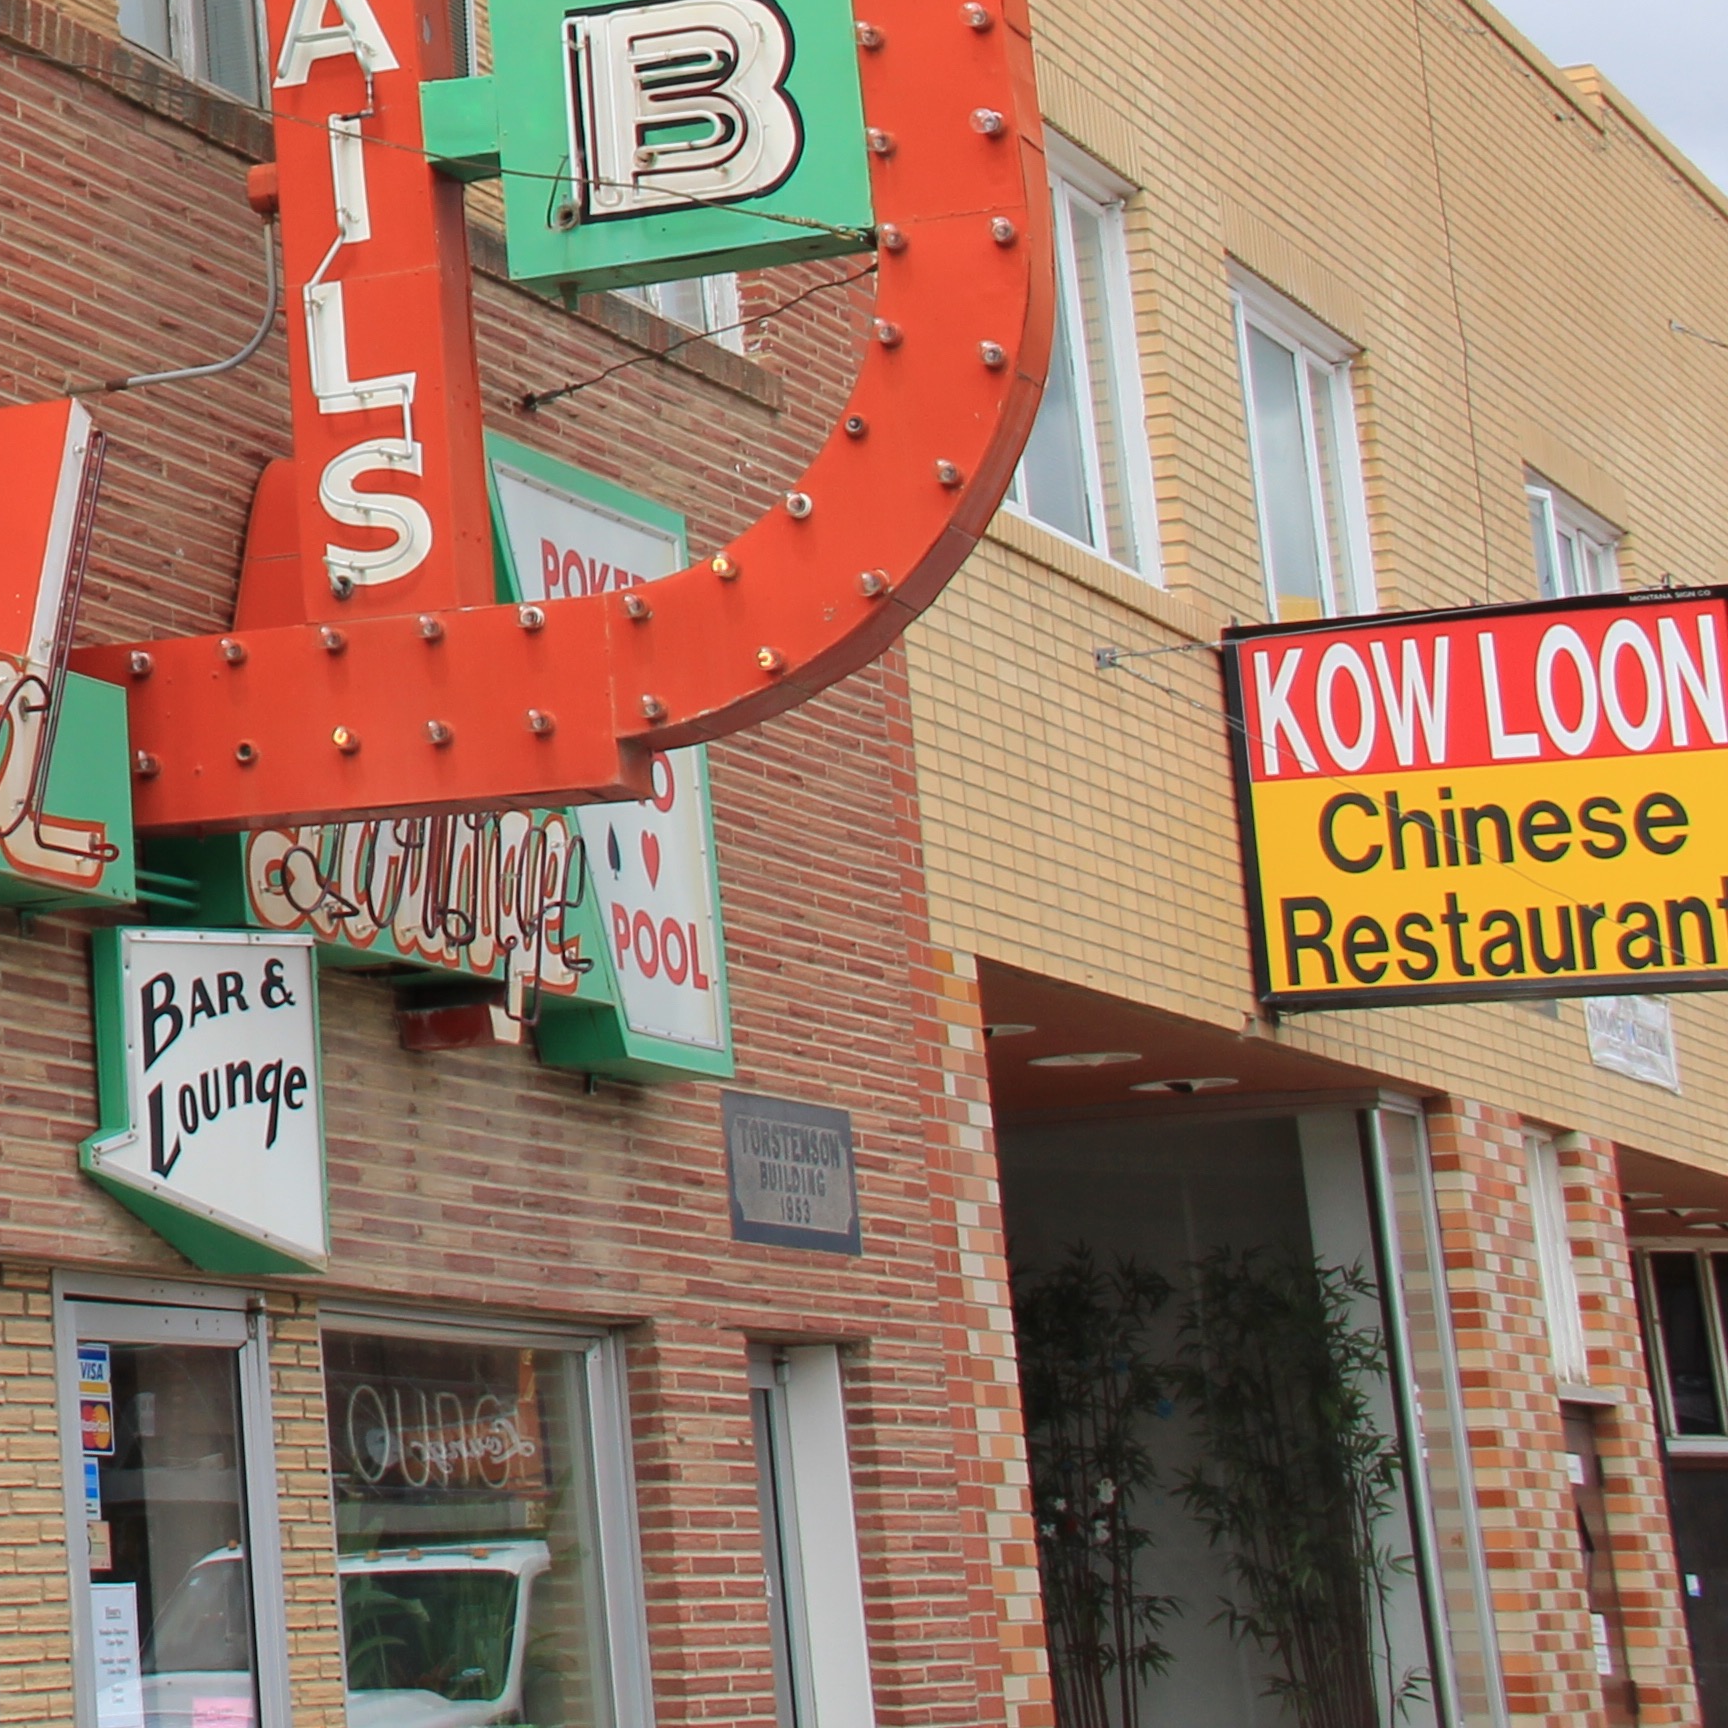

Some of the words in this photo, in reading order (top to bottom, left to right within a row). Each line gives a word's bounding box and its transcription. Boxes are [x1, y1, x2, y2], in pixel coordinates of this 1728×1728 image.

[540, 537, 647, 599] POK
[1629, 593, 1673, 602] MONTANA
[1675, 590, 1696, 599] SIGN
[1253, 635, 1449, 776] KOW
[1478, 614, 1728, 759] LOON
[1319, 787, 1689, 874] Chinese
[611, 902, 709, 991] POOL
[140, 972, 250, 1074] BAR
[260, 958, 296, 1010] &
[148, 1058, 307, 1180] Lounge
[736, 1118, 841, 1169] TORSTENSON
[759, 1161, 826, 1197] BUILDING
[781, 1195, 811, 1223] 1953
[80, 1361, 104, 1382] VISA
